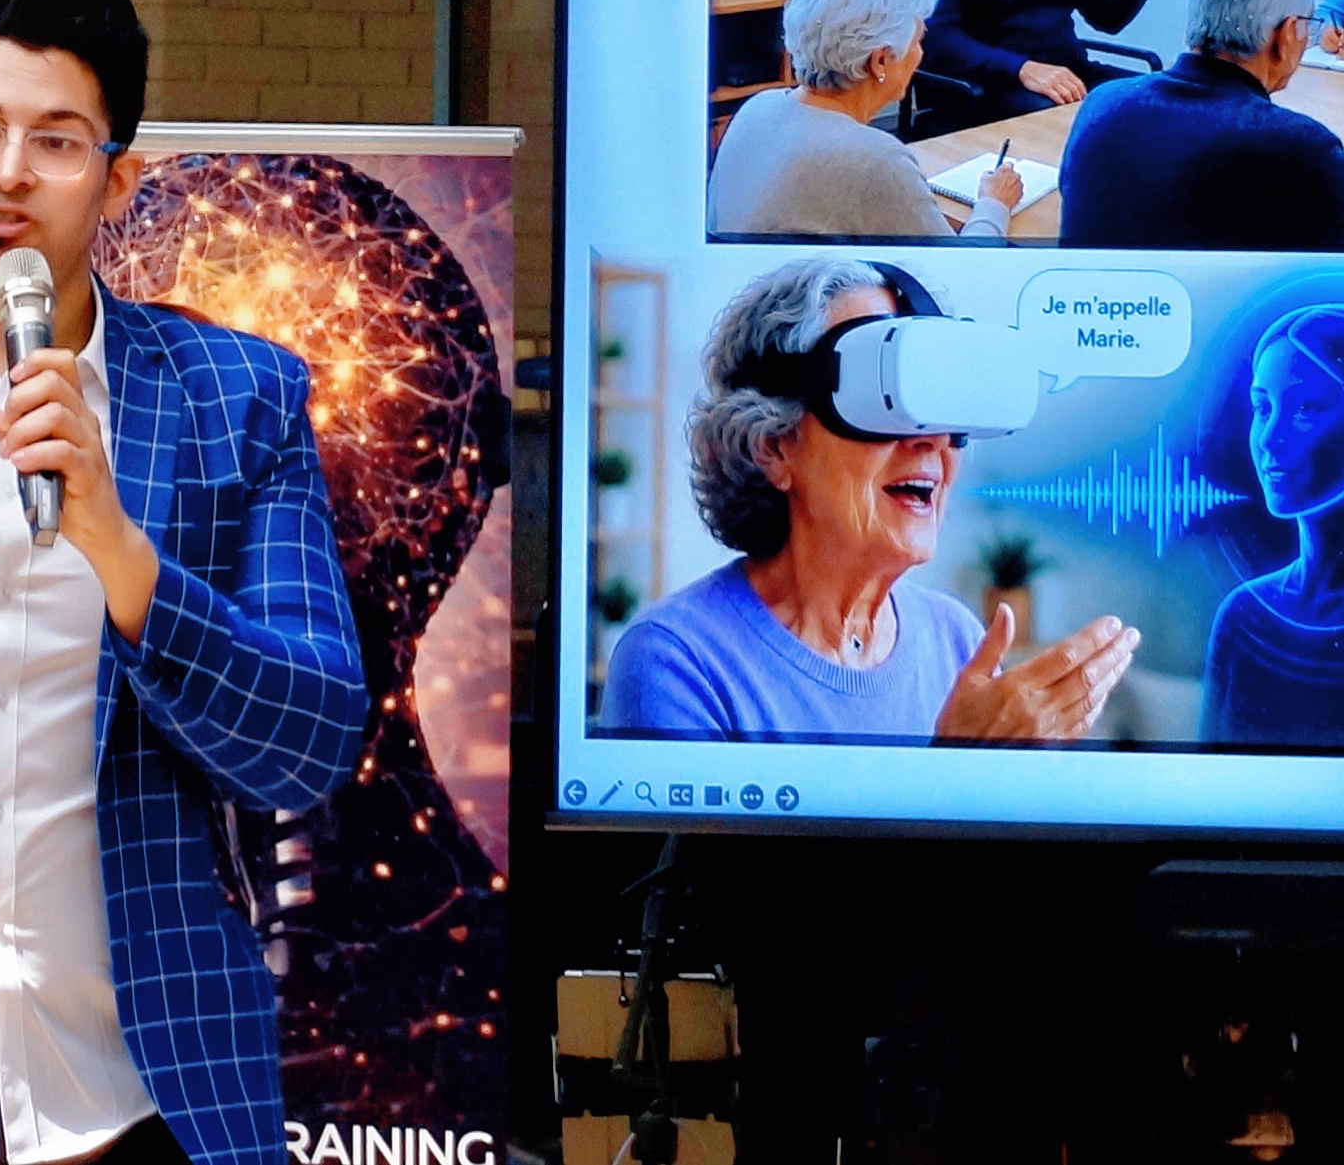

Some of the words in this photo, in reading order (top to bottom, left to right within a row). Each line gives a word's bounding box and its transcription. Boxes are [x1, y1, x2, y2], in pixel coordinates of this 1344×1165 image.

[1042, 295, 1066, 314] Je
[1073, 295, 1171, 320] m'appelle
[1077, 328, 1140, 348] Marie.
[284, 1121, 495, 1165] RAINING
